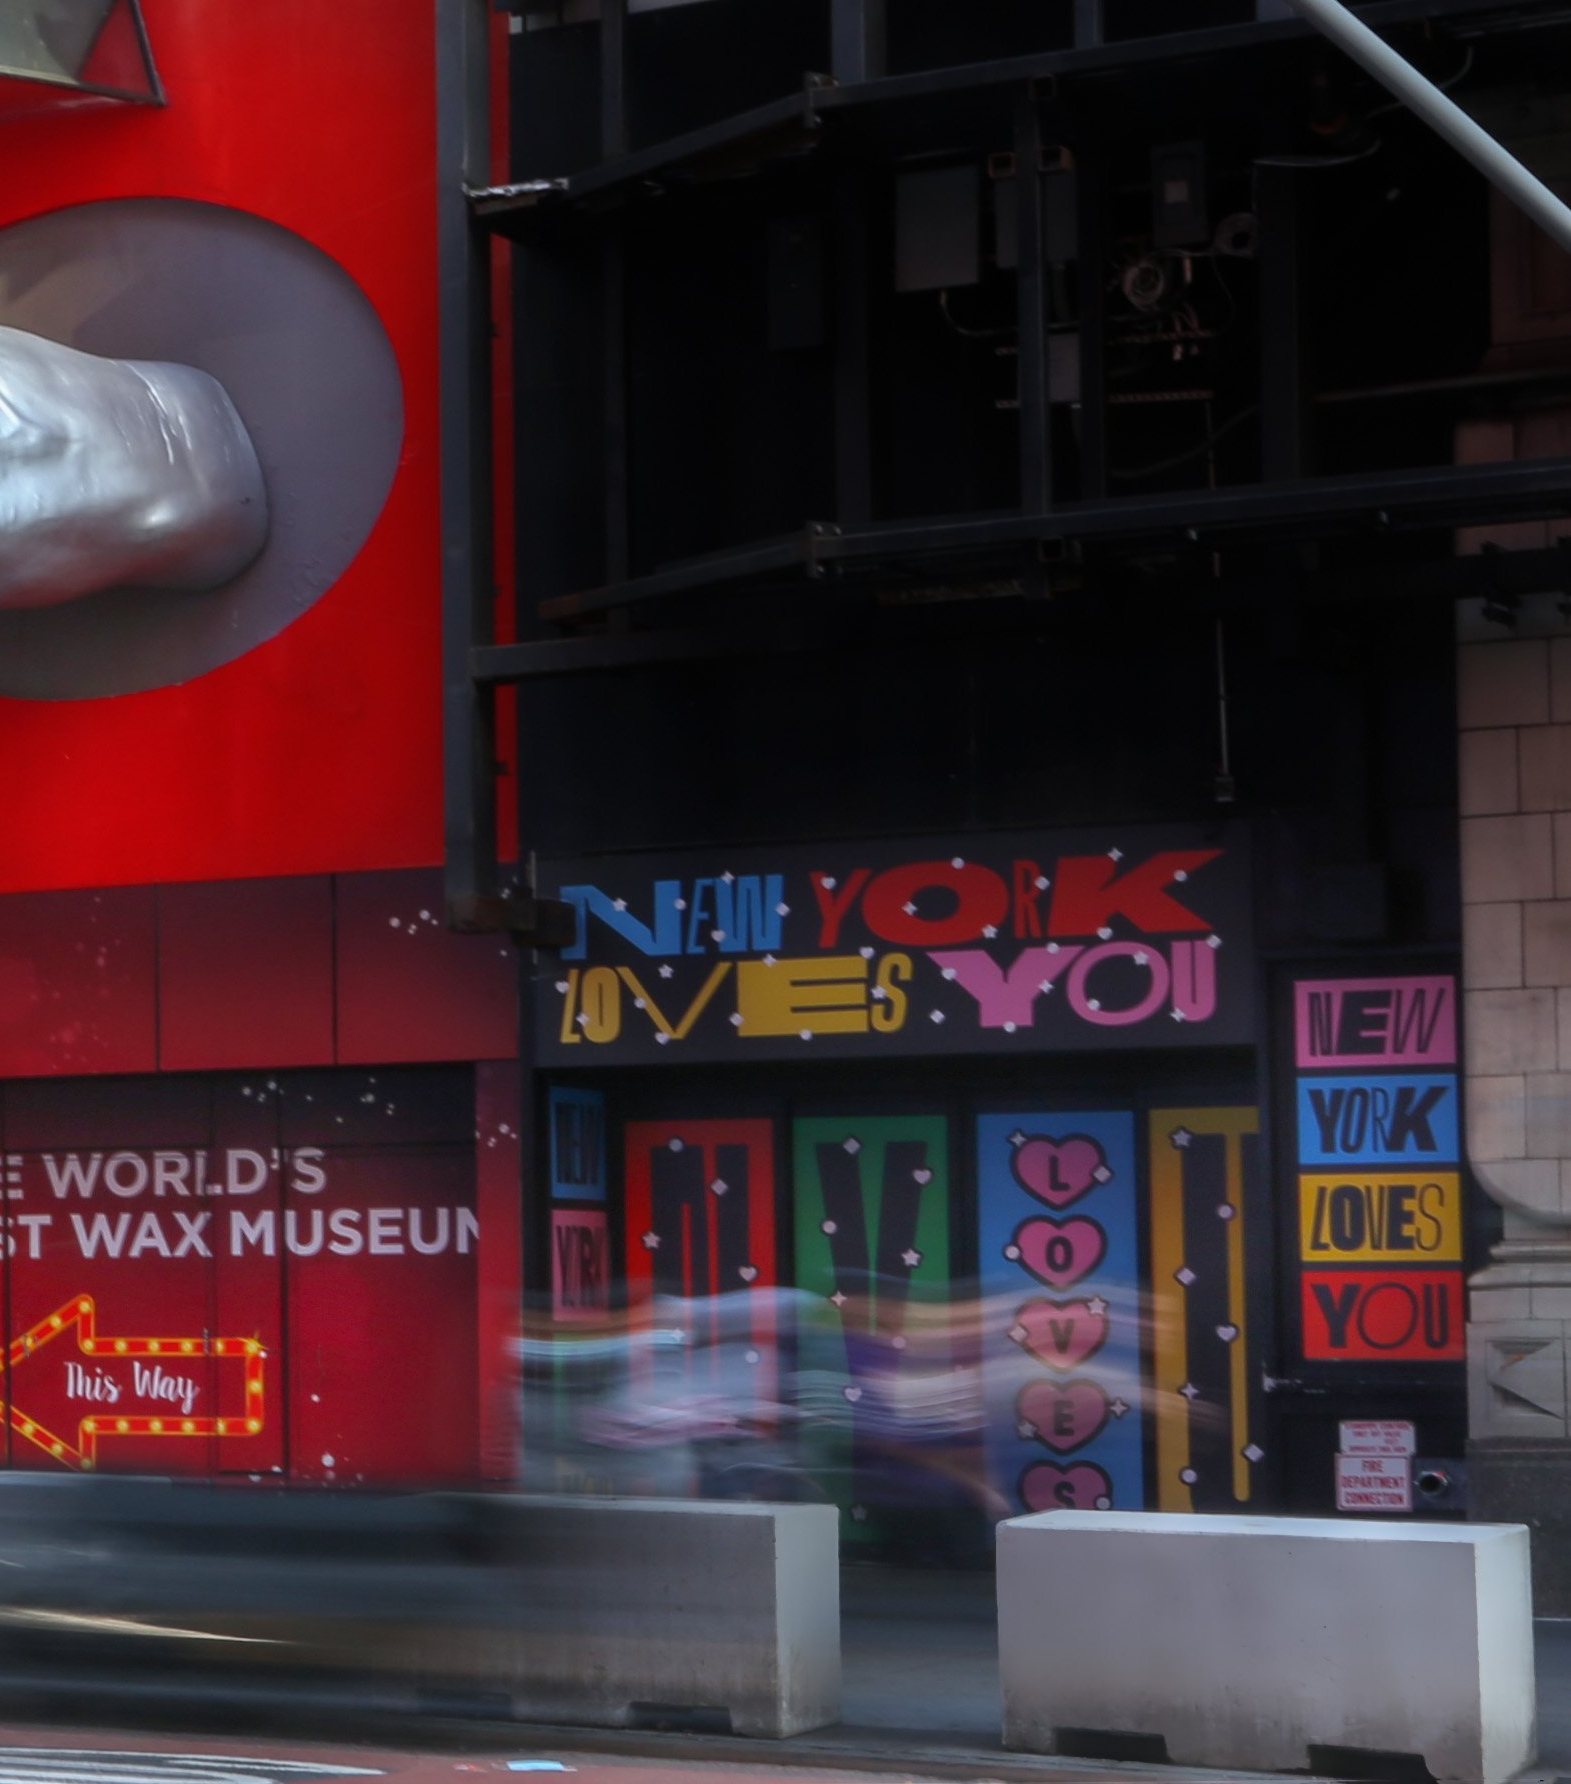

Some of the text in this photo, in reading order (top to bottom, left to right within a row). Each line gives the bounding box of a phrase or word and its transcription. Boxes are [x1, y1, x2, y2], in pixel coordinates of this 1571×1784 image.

[560, 848, 1226, 960] NEW YORK
[559, 938, 1218, 1044] LOVES YOU
[1306, 986, 1447, 1058] NEW
[1306, 1085, 1450, 1155] YORK
[42, 1147, 327, 1200] WORLD'S
[69, 1210, 214, 1259] WAX
[1309, 1181, 1446, 1252] LOVES
[1310, 1280, 1450, 1350] YOU
[63, 1360, 201, 1415] This Way
